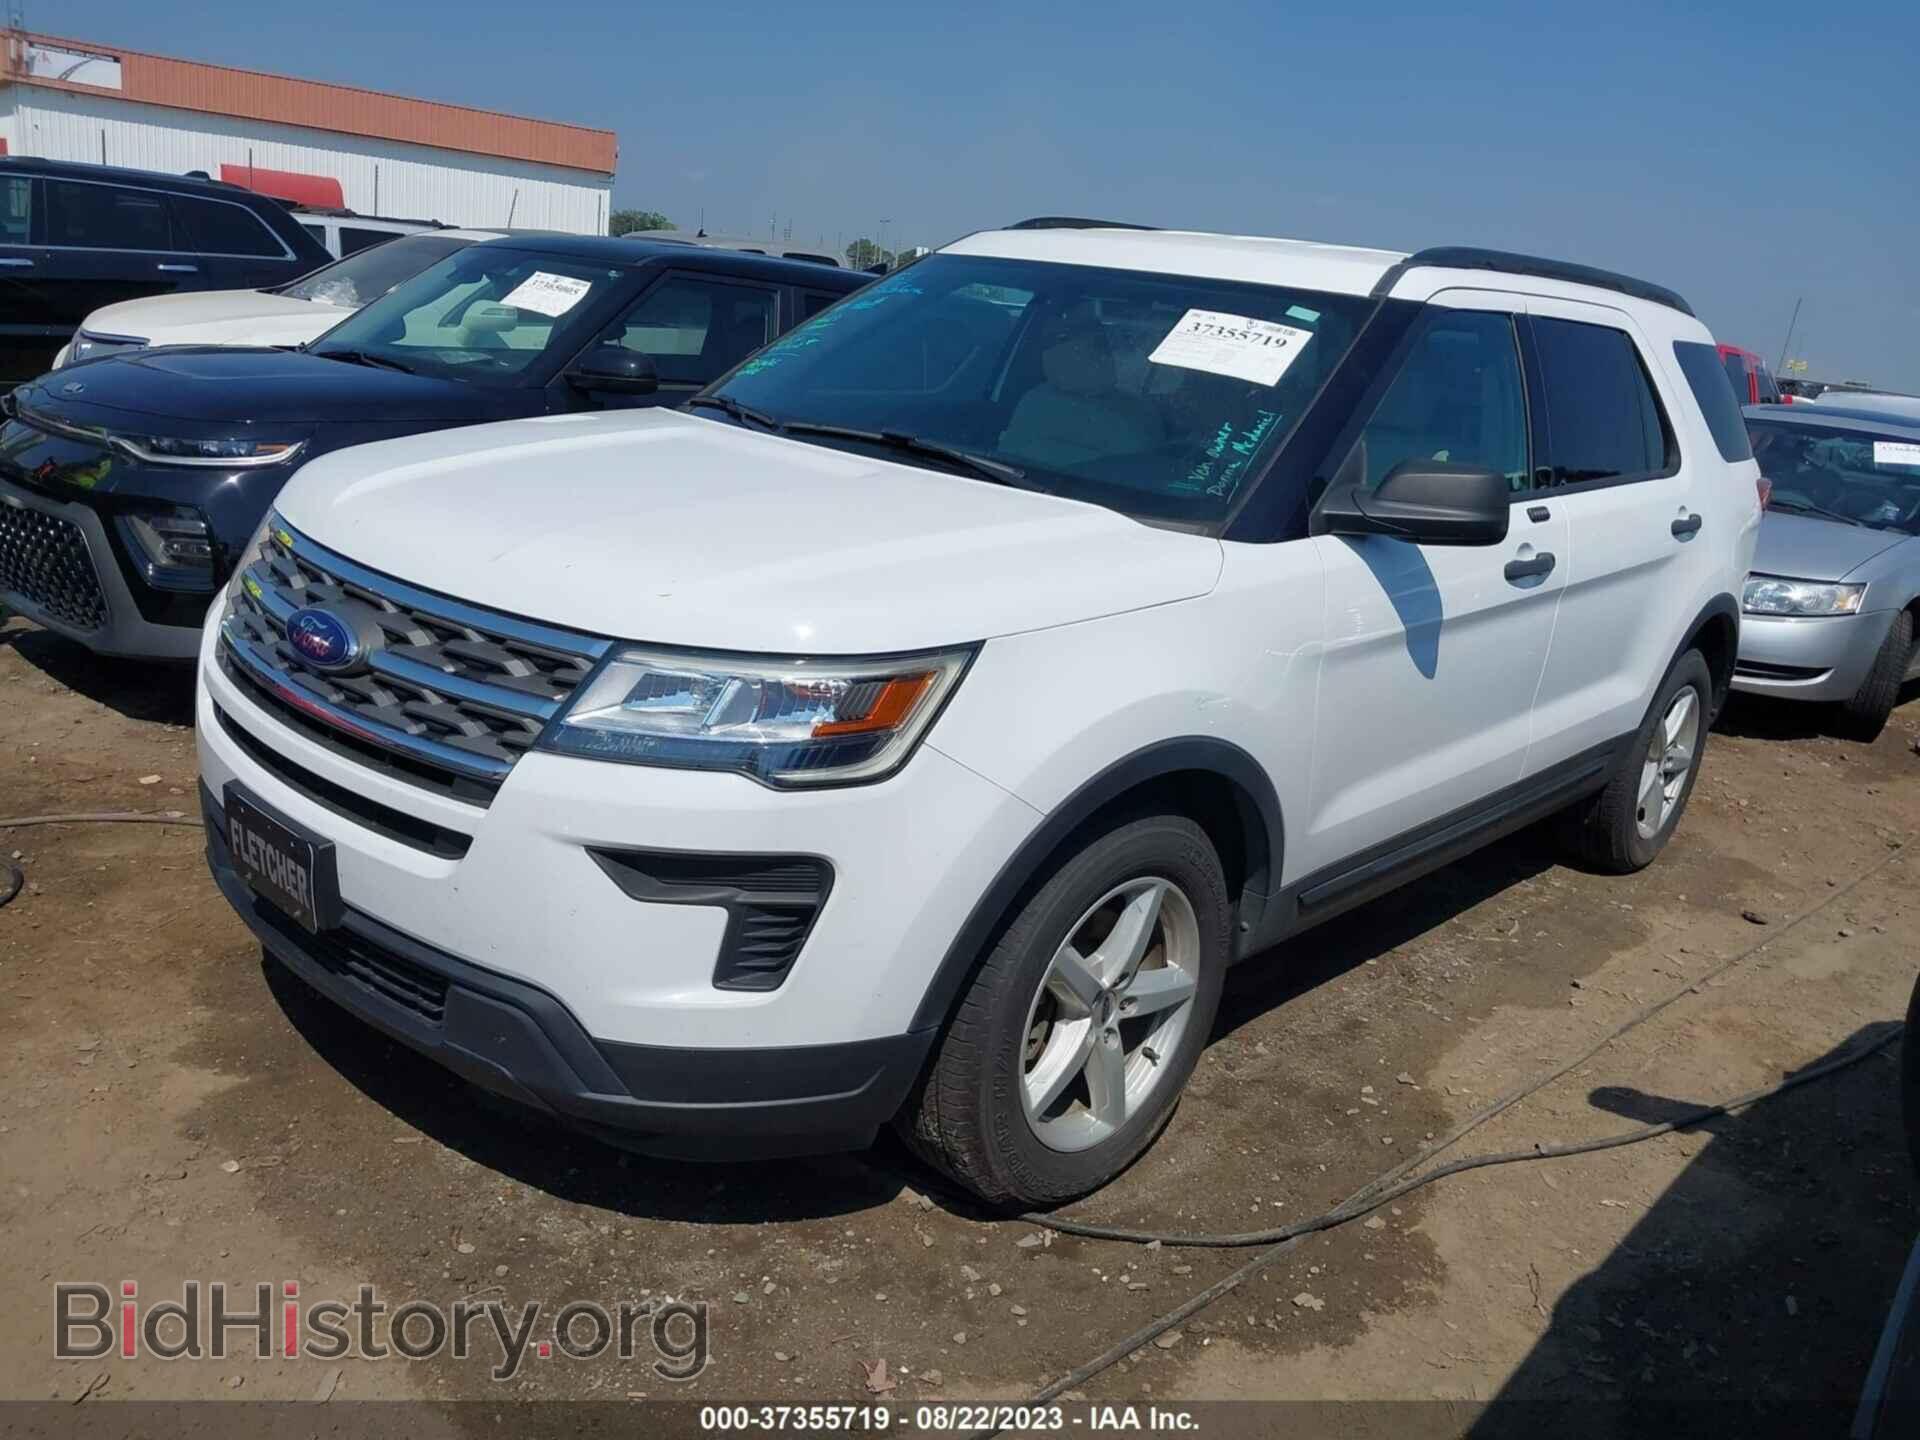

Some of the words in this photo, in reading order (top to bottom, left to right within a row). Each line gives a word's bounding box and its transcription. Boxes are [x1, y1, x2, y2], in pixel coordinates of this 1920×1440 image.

[1187, 322, 1288, 348] 37355719
[292, 615, 335, 657] Ford
[230, 818, 311, 909] FLETCHER
